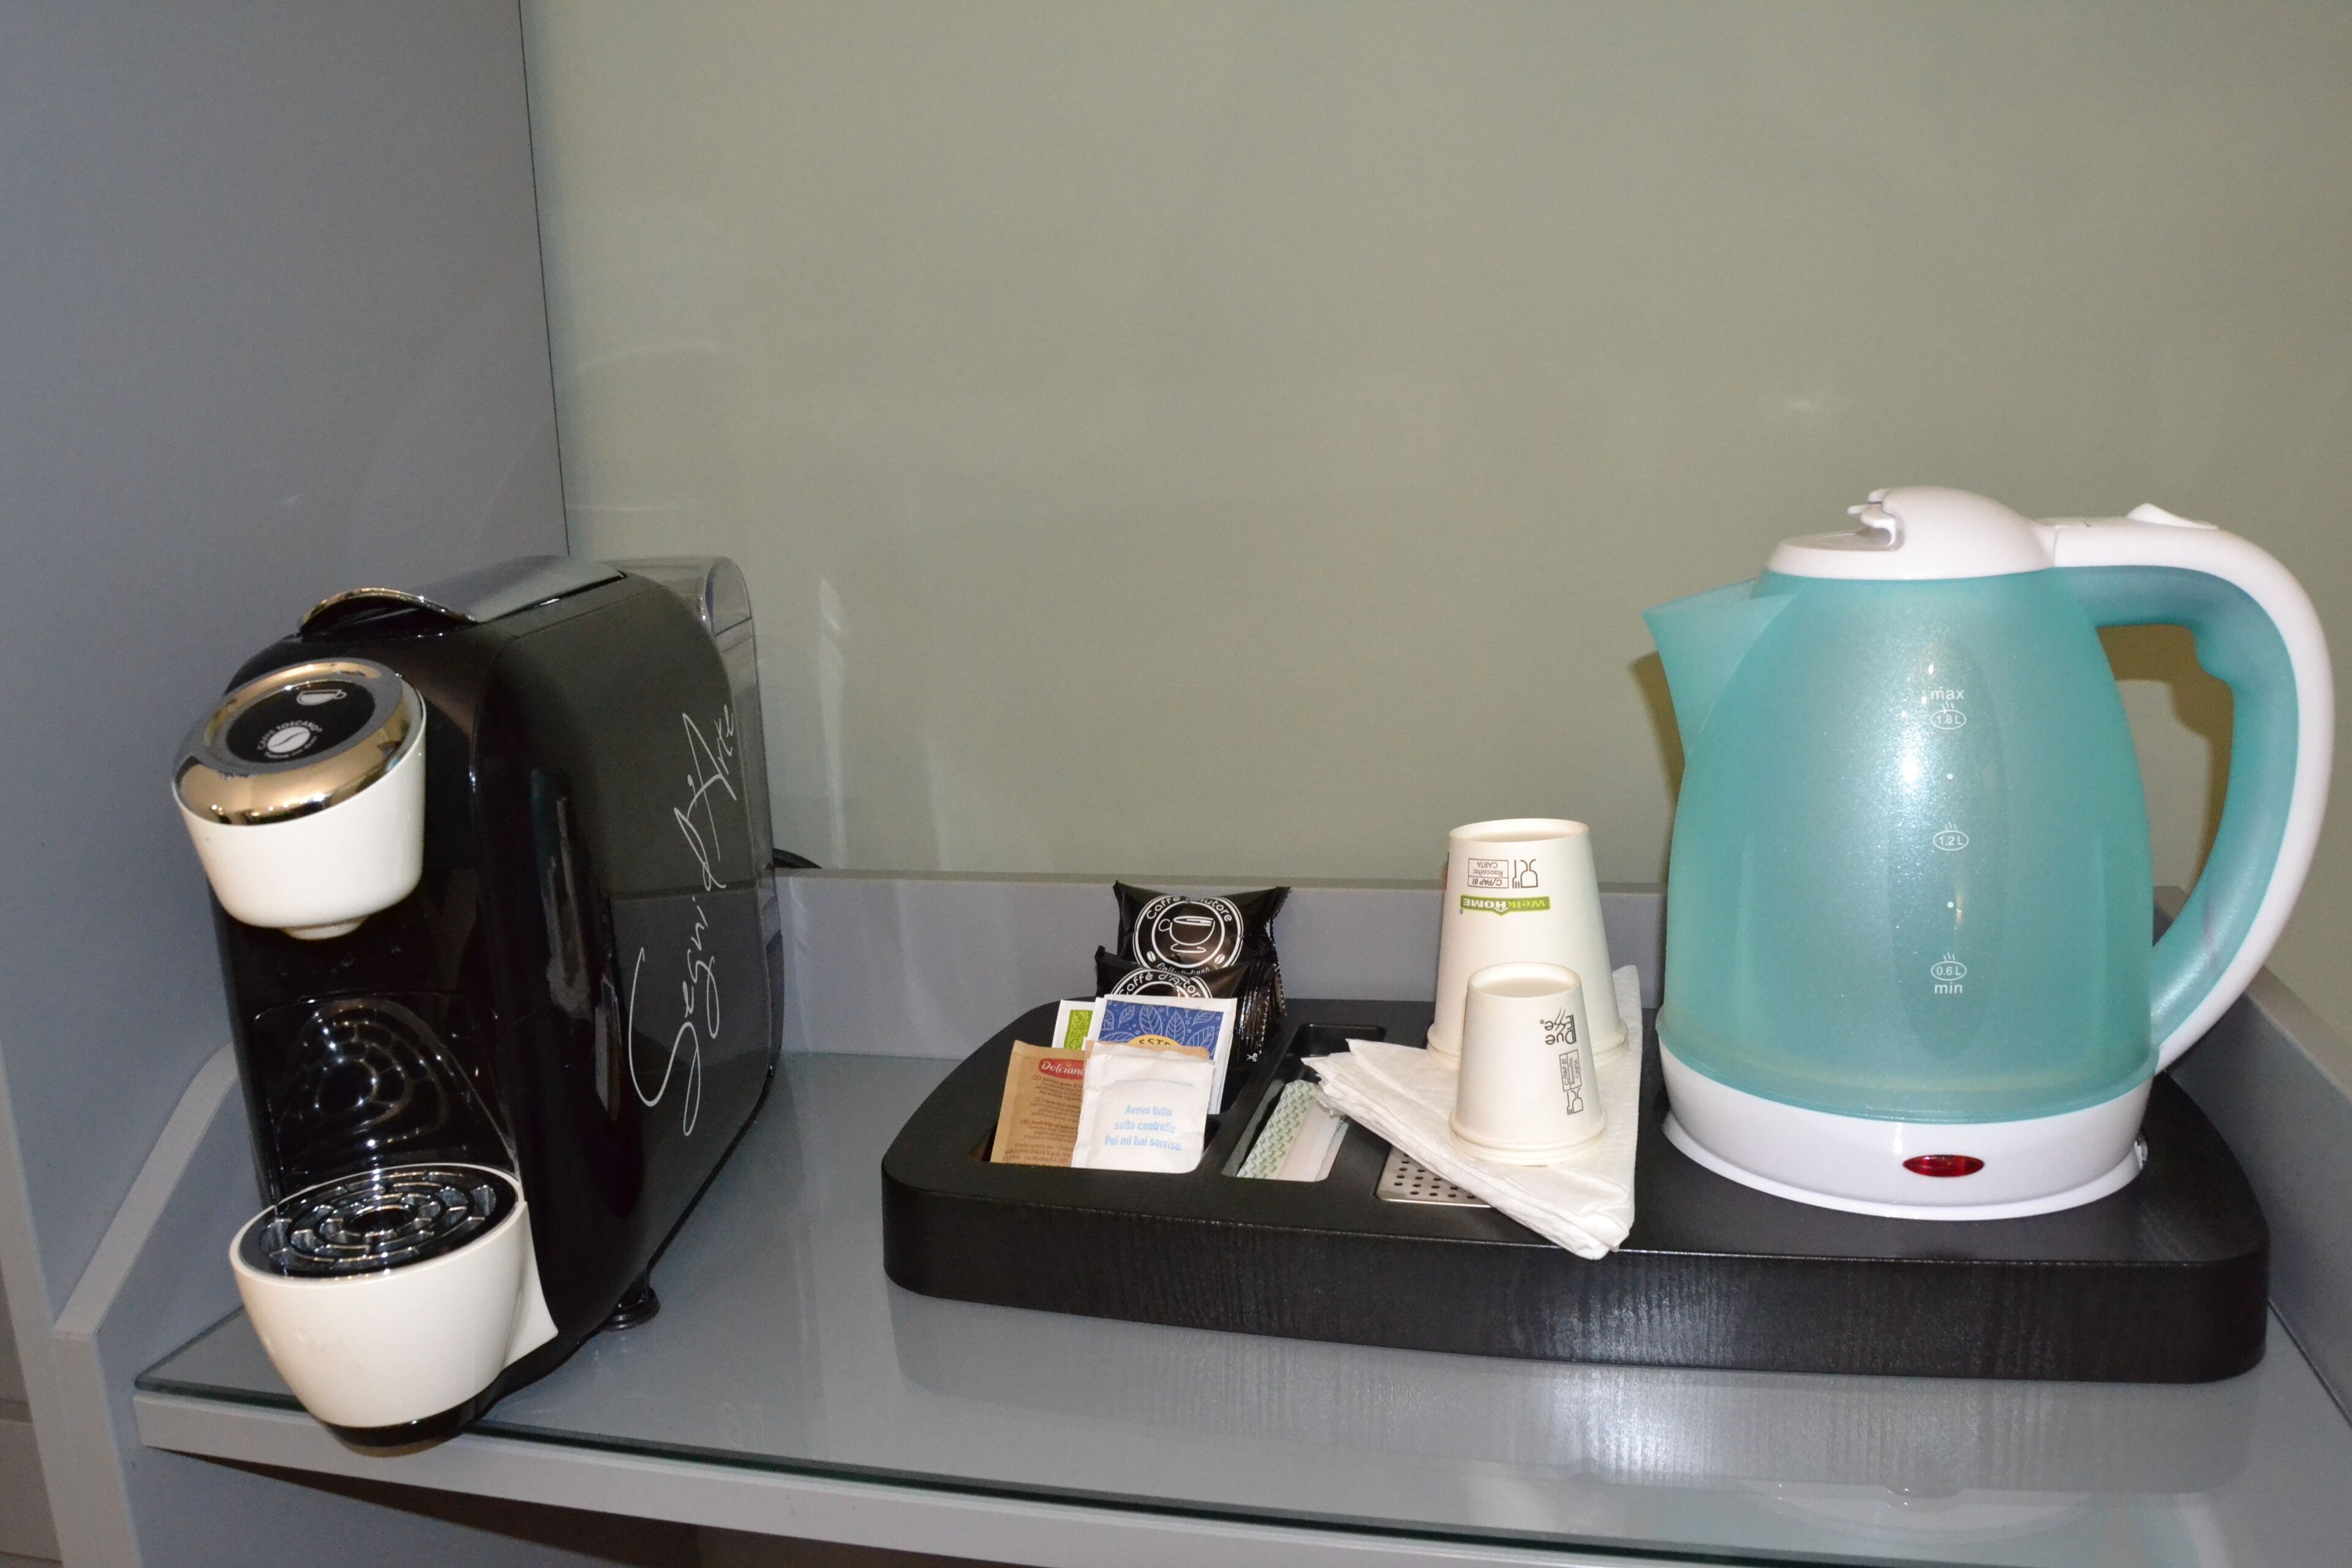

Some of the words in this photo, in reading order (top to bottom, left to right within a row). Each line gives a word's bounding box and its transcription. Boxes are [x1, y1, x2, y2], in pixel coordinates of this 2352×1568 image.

[1931, 690, 1964, 699] max
[1937, 714, 1952, 725] 1.8
[1955, 715, 1961, 724] L
[1939, 836, 1954, 845] 1.2
[1958, 836, 1964, 845] L
[1472, 869, 1503, 877] Raccolta:
[1479, 877, 1502, 886] C/PAP
[1936, 966, 1953, 976] 0.6
[1955, 967, 1961, 976] L
[1935, 981, 1963, 994] min
[1545, 1029, 1577, 1045] Due
[1125, 1104, 1150, 1115] Avevo
[1153, 1106, 1172, 1117] tutto
[1114, 1120, 1135, 1130] sotto
[1137, 1121, 1175, 1133] controllo
[1105, 1134, 1118, 1145] Poi
[1120, 1136, 1131, 1145] mi
[1134, 1136, 1148, 1146] hai
[1150, 1137, 1183, 1152] sorriso.
